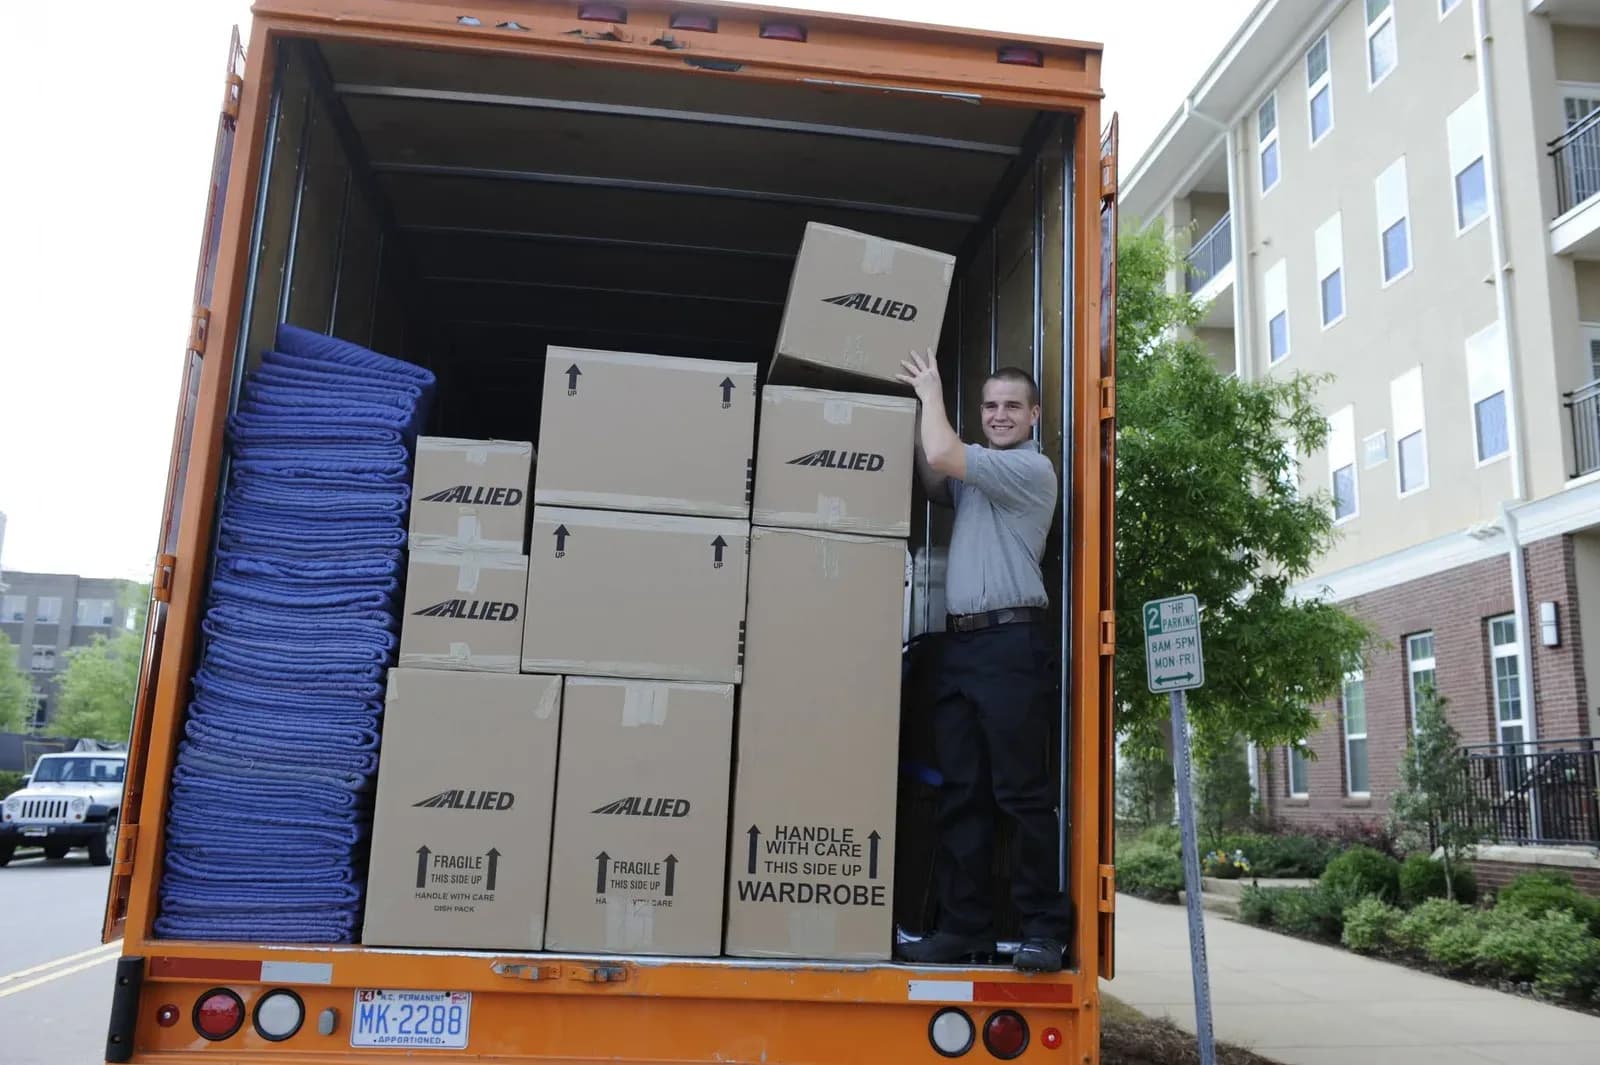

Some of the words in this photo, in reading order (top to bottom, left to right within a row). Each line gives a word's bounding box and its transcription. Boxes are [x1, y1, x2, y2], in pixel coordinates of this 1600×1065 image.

[845, 292, 918, 322] ALLIED
[722, 402, 731, 410] UP
[810, 449, 885, 472] ALLIED
[445, 485, 523, 506] ALLIED
[437, 599, 520, 622] ALLIED
[1147, 607, 1160, 630] 2
[1171, 602, 1184, 614] HR
[1162, 614, 1196, 630] PARKING
[441, 790, 515, 811] ALLIED
[615, 797, 691, 818] ALLIED
[775, 824, 854, 843] HANDLE
[766, 840, 809, 855] WITH
[814, 842, 862, 857] CARE
[433, 855, 483, 870] FRAGILE
[613, 861, 661, 876] FRAGILE
[764, 860, 798, 874] THIS
[802, 862, 837, 876] SIDE
[842, 864, 862, 876] UP
[431, 873, 449, 884] THIS
[450, 874, 469, 884] SIDE
[470, 875, 482, 885] UP
[610, 879, 629, 890] THIS
[629, 880, 648, 890] SIDE
[649, 880, 661, 890] UP
[415, 892, 448, 900] HANDLE
[450, 893, 470, 901] WITH
[472, 894, 495, 902] CARE
[737, 880, 886, 907] WARDROBE
[398, 993, 445, 1002] PERMANENT
[359, 1003, 462, 1035] MK-2288
[378, 1035, 441, 1044] APPORTIONED
